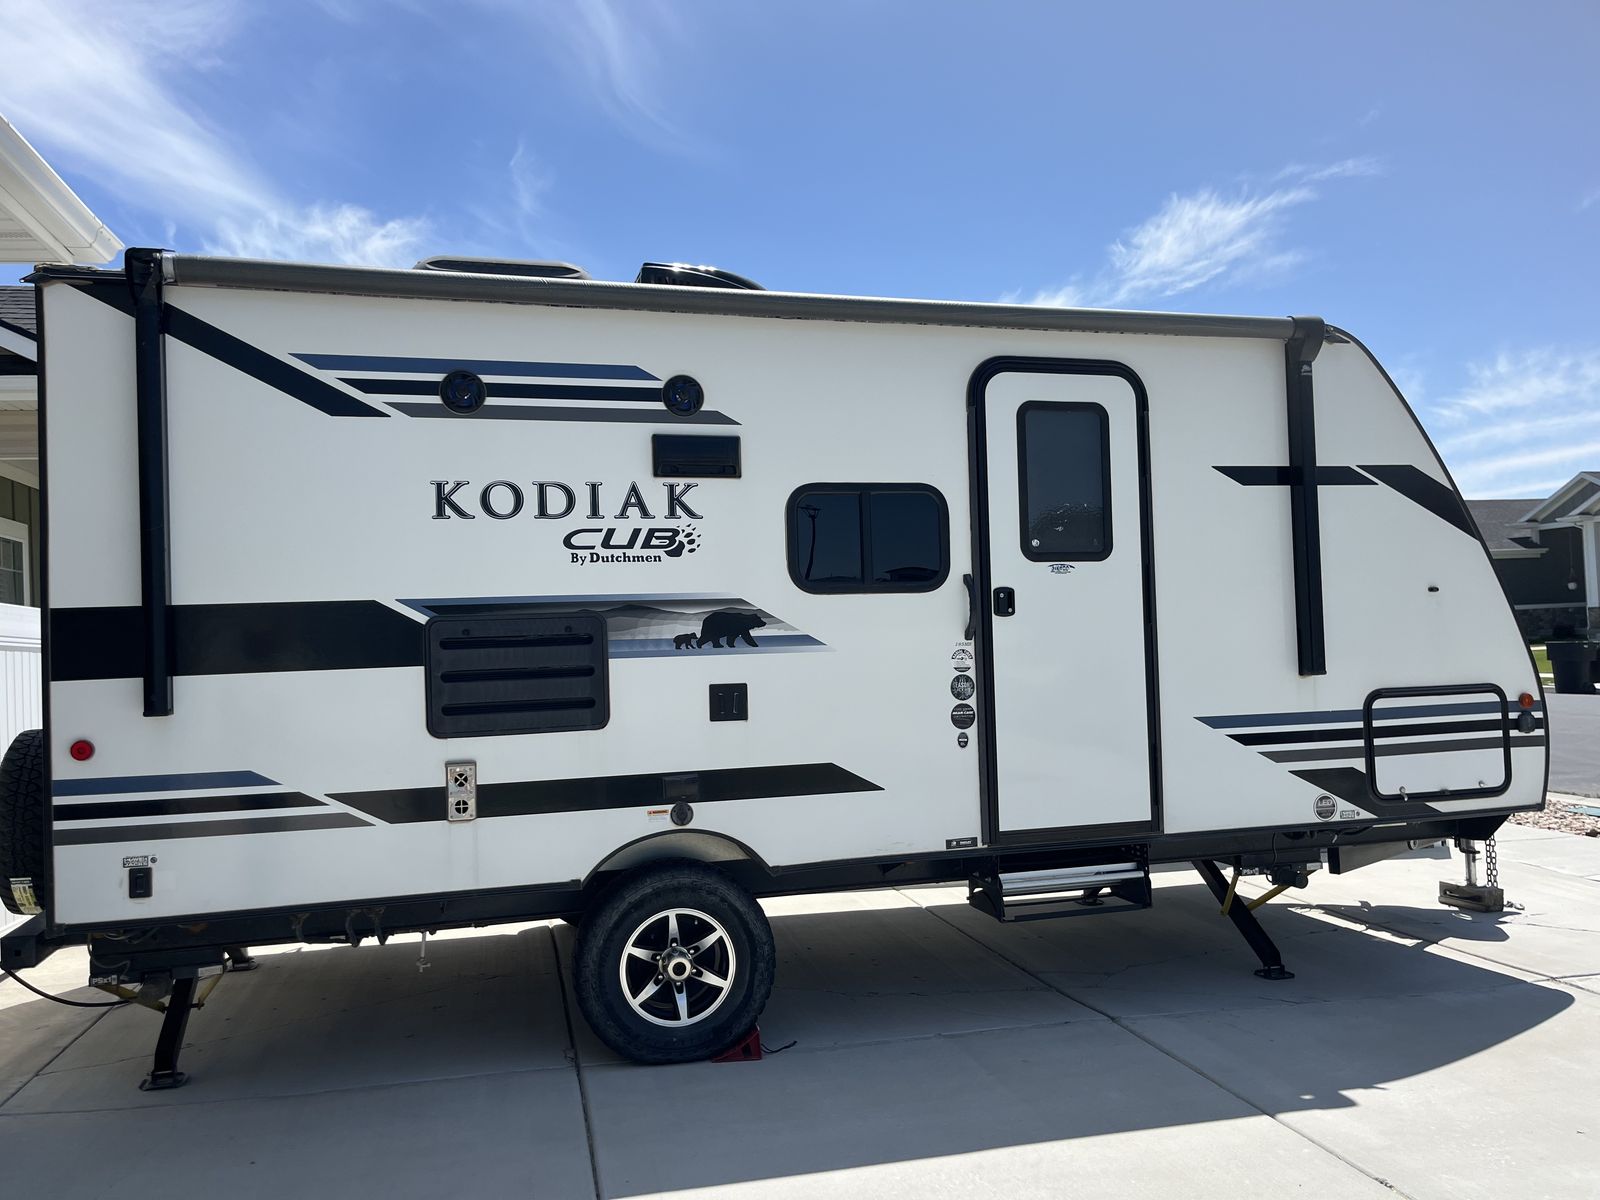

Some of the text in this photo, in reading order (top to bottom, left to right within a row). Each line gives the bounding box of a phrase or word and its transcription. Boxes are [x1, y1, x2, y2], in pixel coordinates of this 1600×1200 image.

[430, 480, 703, 520] KODIAK
[563, 527, 681, 550] CUB
[570, 551, 662, 566] By Dutchmen
[1317, 799, 1333, 807] LED
